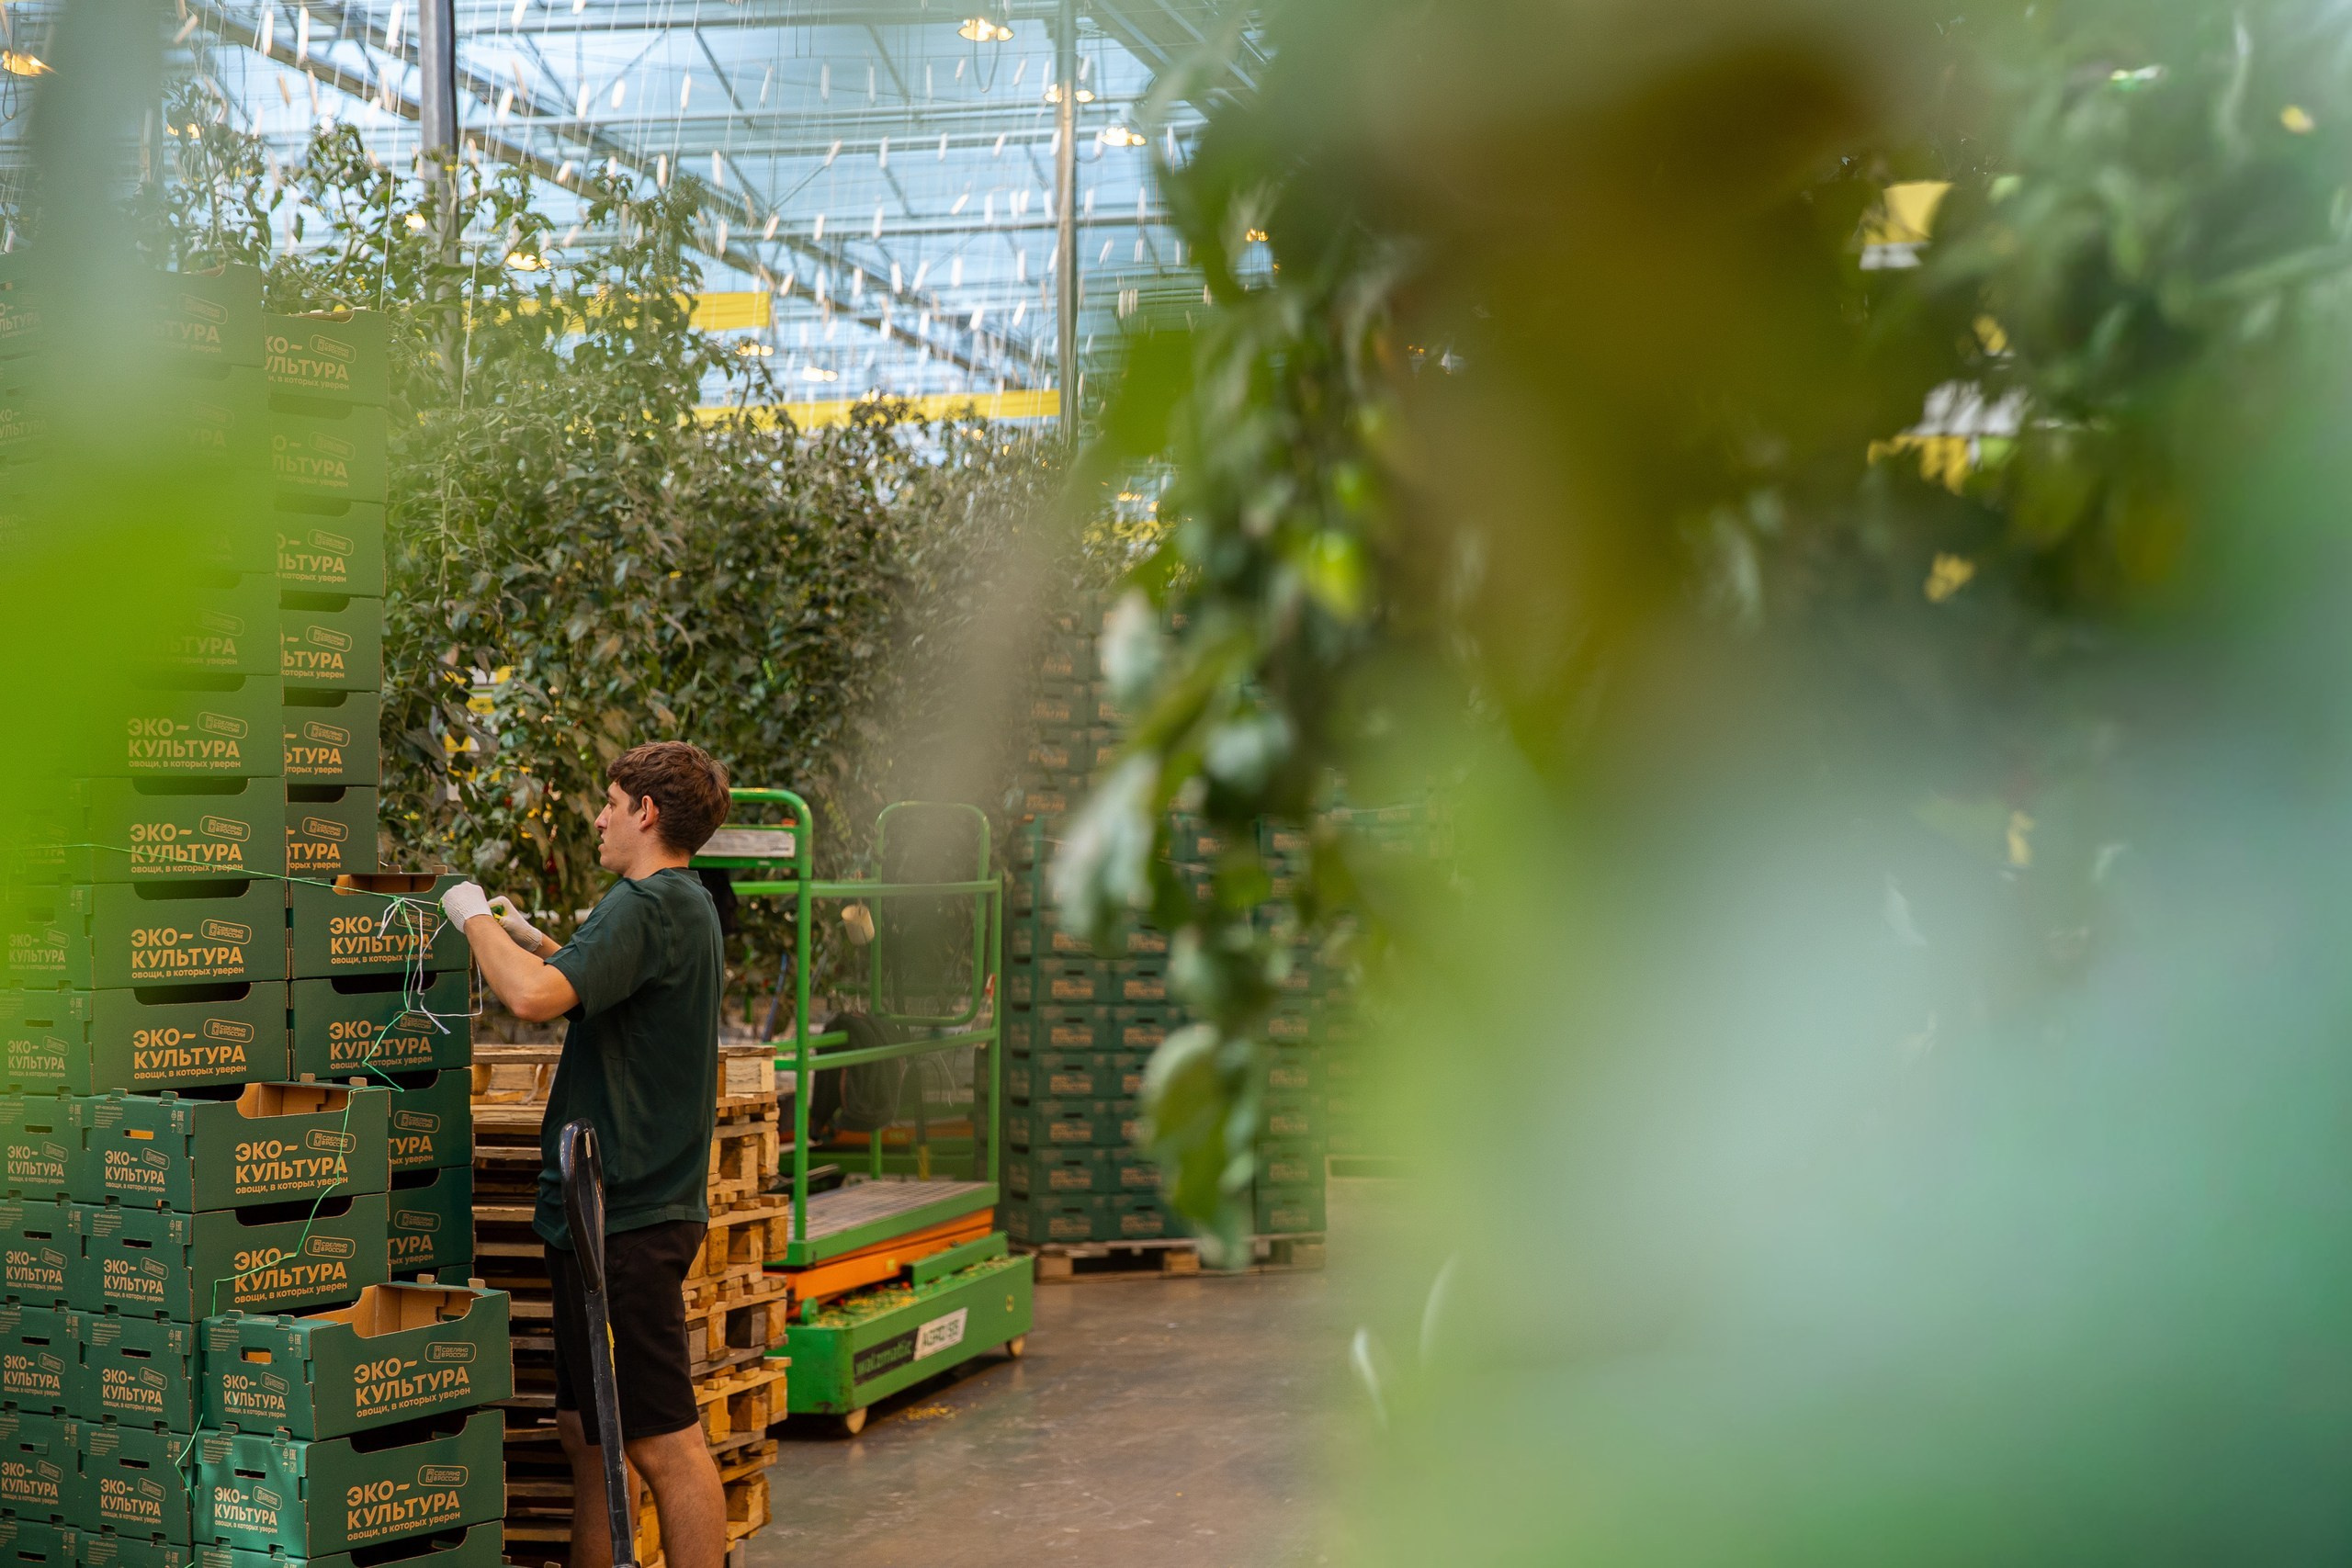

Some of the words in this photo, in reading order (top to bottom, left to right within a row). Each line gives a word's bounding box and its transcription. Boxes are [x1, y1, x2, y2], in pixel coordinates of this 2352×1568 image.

[266, 336, 303, 354] КО-
[265, 355, 349, 381] УЛЬТУРА
[284, 377, 319, 387] которых
[321, 381, 349, 390] уверен
[282, 572, 317, 582] которых
[318, 575, 346, 583] уверен
[283, 650, 345, 670] ЬТУРА
[316, 671, 345, 680] уверен
[128, 718, 189, 736] ЭКО-
[129, 739, 240, 757] КУЛЬТУРА
[287, 766, 312, 775] торых
[314, 766, 343, 775] уверен
[130, 823, 192, 841] ЭКО-
[130, 843, 243, 863] КУЛЬТУРА
[289, 843, 341, 860] ТУРА
[312, 862, 341, 871] уверен
[331, 916, 386, 934] ЭКО-
[131, 928, 193, 947] ЭКО-
[331, 934, 432, 954] КУЛЬТУРА
[9, 949, 65, 963] КУЛЬТУРА
[131, 946, 243, 968] КУЛЬТУРА
[134, 1028, 196, 1048] ЭКО-
[330, 1020, 386, 1040] ЭКО-
[7, 1040, 39, 1053] ЭКО-
[330, 1037, 432, 1059] КУЛЬТУРА
[7, 1055, 64, 1069] КУЛЬТУРА
[134, 1045, 245, 1068] КУЛЬТУРА
[135, 1071, 167, 1079] овощи,
[7, 1145, 39, 1159] ЭКО-
[105, 1150, 138, 1165] ЭКО-
[236, 1140, 298, 1161] ЭКО-
[7, 1161, 63, 1176] КУЛЬТУРА
[405, 1155, 434, 1165] уверен
[105, 1166, 164, 1184] КУЛЬТУРА
[235, 1156, 347, 1183] КУЛЬТУРА
[236, 1185, 268, 1194] овощи,
[277, 1181, 314, 1190] которых
[6, 1250, 38, 1265] ЭКО-
[104, 1258, 137, 1274] ЭКО-
[235, 1247, 297, 1270] ЭКО-
[405, 1254, 434, 1265] уверен
[6, 1266, 62, 1282] КУЛЬТУРА
[234, 1261, 346, 1292] КУЛЬТУРА
[104, 1275, 164, 1293] КУЛЬТУРА
[235, 1293, 267, 1303] овощи,
[277, 1288, 313, 1297] которых
[316, 1282, 347, 1292] уверен
[4, 1355, 35, 1370] ЭКО-
[355, 1358, 417, 1383] ЭКО-
[4, 1371, 60, 1388] КУЛЬТУРА
[103, 1369, 136, 1384] ЭКО-
[223, 1374, 257, 1390] ЭКО-
[102, 1384, 162, 1404] КУЛЬТУРА
[356, 1367, 469, 1406] КУЛЬТУРА
[224, 1391, 285, 1409] КУЛЬТУРА
[357, 1405, 390, 1417] овощи,
[399, 1395, 435, 1407] которых
[439, 1388, 470, 1399] уверен
[2, 1461, 33, 1477] ЭКО-
[1, 1477, 58, 1496] КУЛЬТУРА
[101, 1478, 134, 1495] ЭКО-
[214, 1486, 249, 1503] ЭКО-
[347, 1480, 410, 1506] ЭКО-
[100, 1495, 161, 1516] КУЛЬТУРА
[214, 1503, 277, 1525] КУЛЬТУРА
[347, 1491, 459, 1529] КУЛЬТУРА
[348, 1529, 380, 1540] овощи,
[390, 1519, 426, 1531] которых
[429, 1513, 460, 1524] уверен
